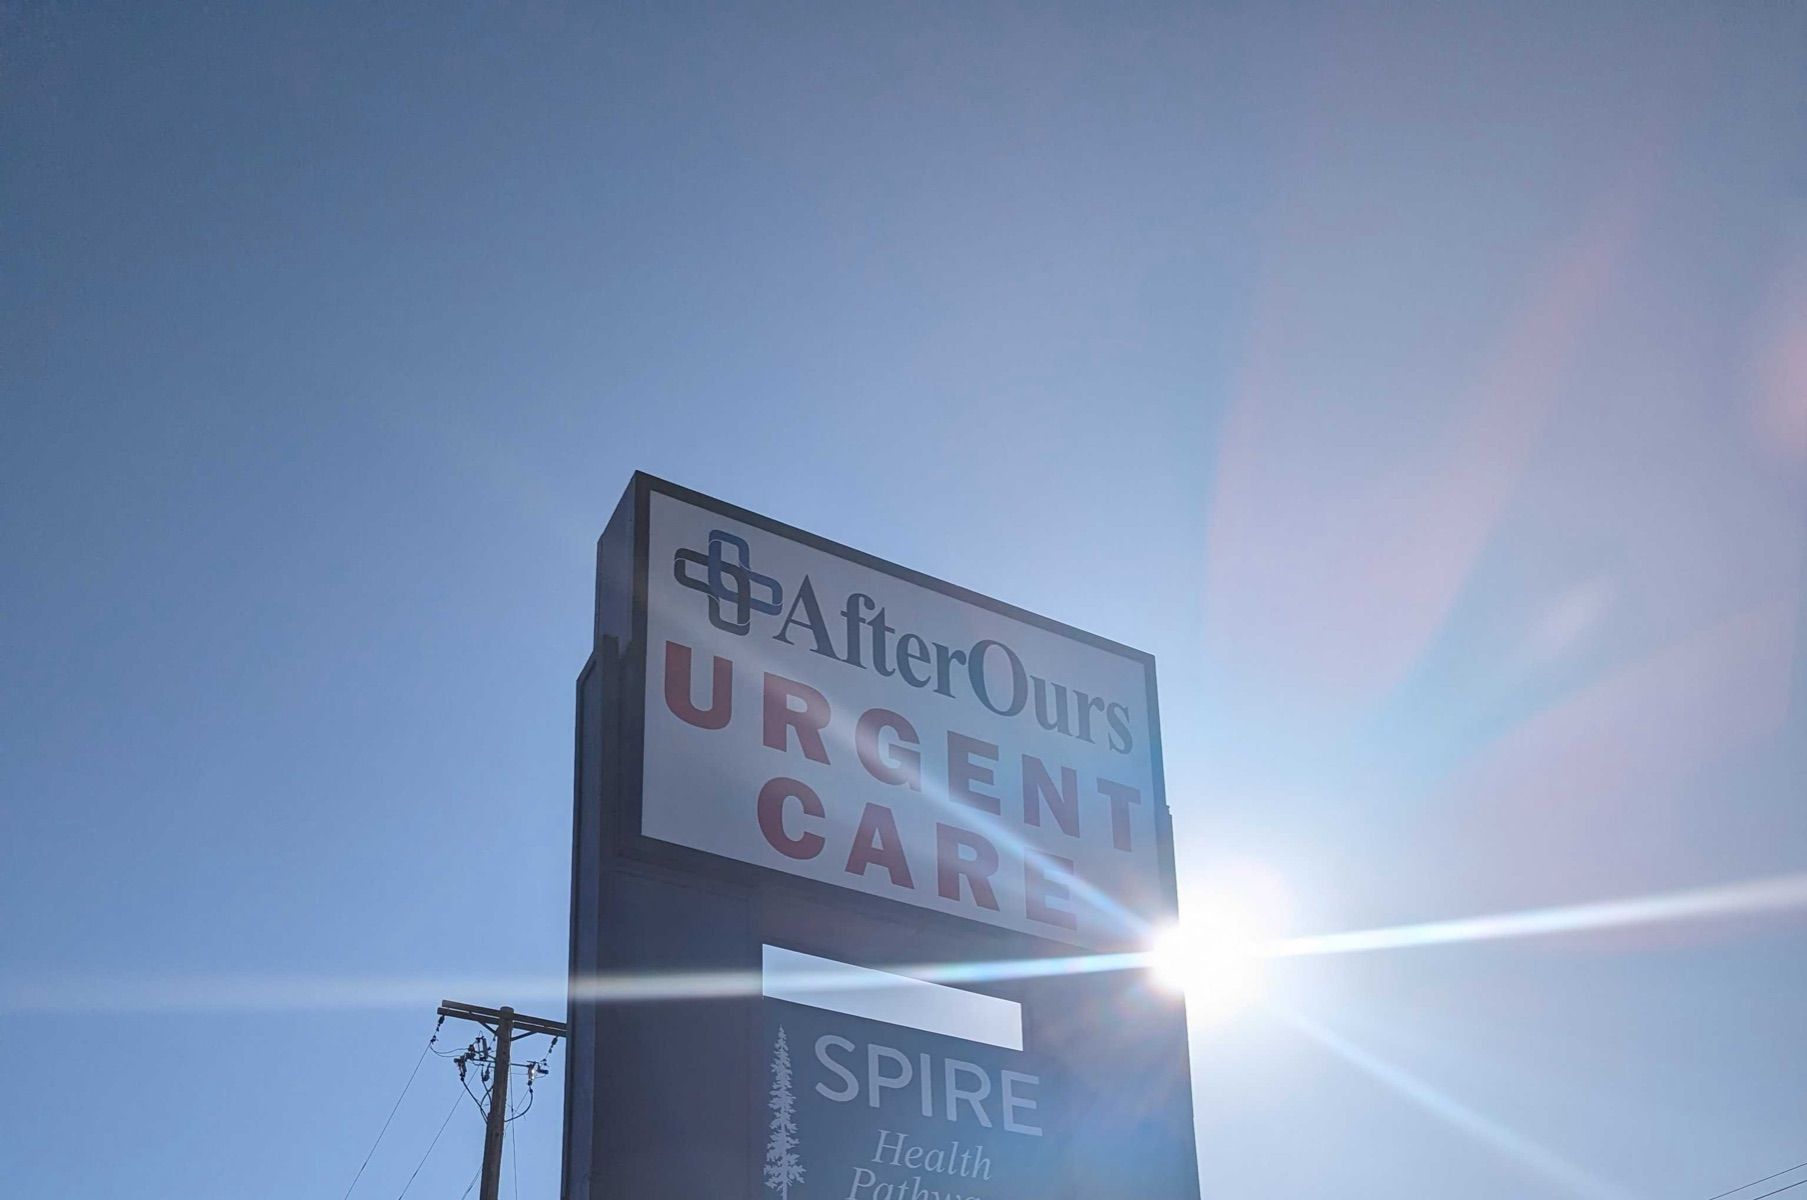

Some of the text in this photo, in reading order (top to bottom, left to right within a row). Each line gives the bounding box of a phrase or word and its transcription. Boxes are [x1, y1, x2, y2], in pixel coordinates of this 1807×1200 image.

[772, 574, 1134, 755] AfterOurs
[664, 641, 1142, 853] URGENT
[757, 777, 1078, 931] CARE
[814, 1034, 1043, 1137] SPIRE
[872, 1129, 992, 1181] Health
